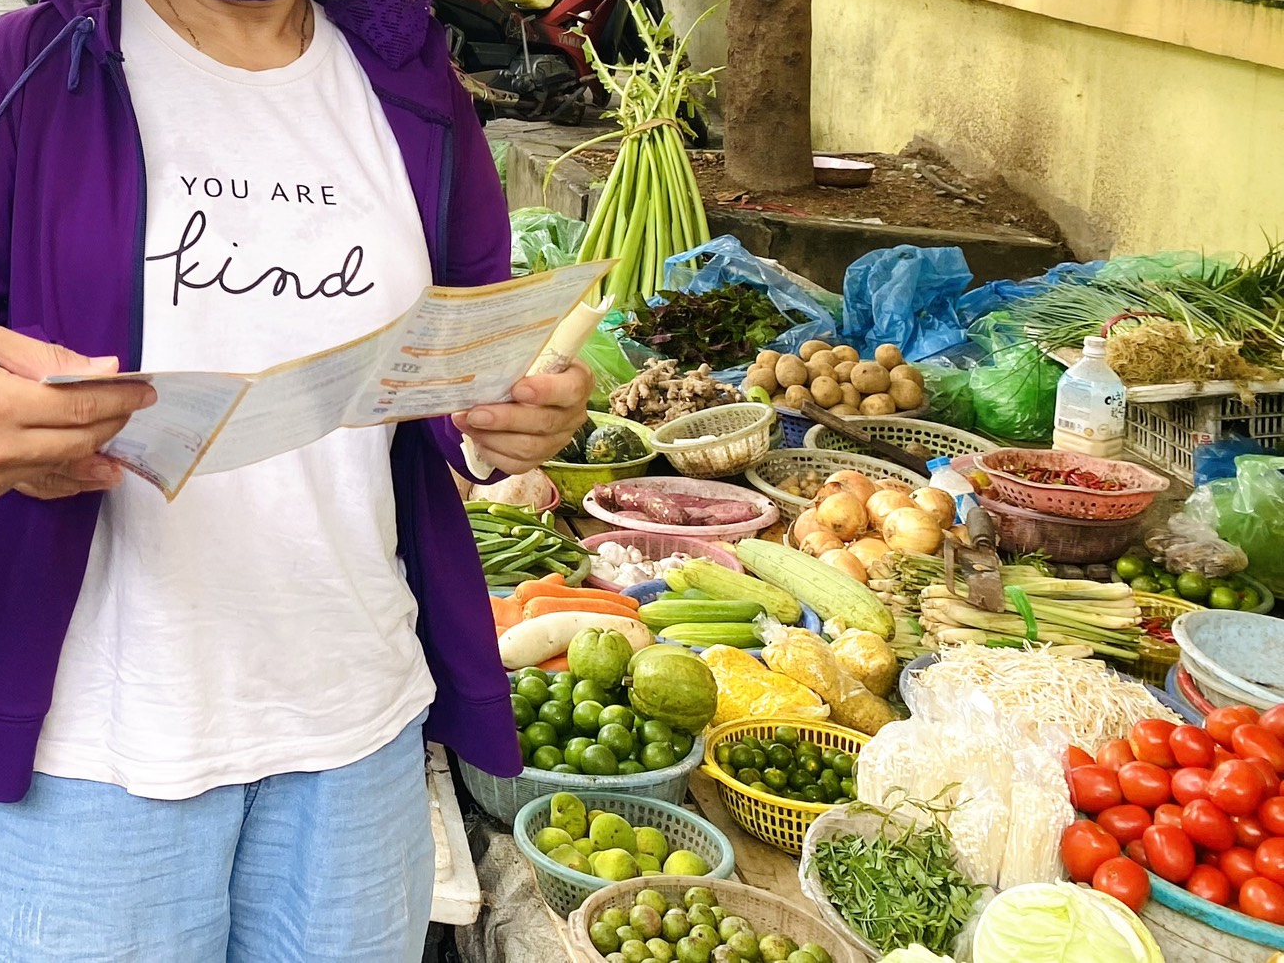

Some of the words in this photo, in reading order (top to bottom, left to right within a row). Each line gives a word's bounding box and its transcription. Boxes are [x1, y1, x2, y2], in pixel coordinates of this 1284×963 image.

[180, 175, 249, 199] YOU
[271, 182, 338, 206] ARE
[145, 210, 375, 307] kind
